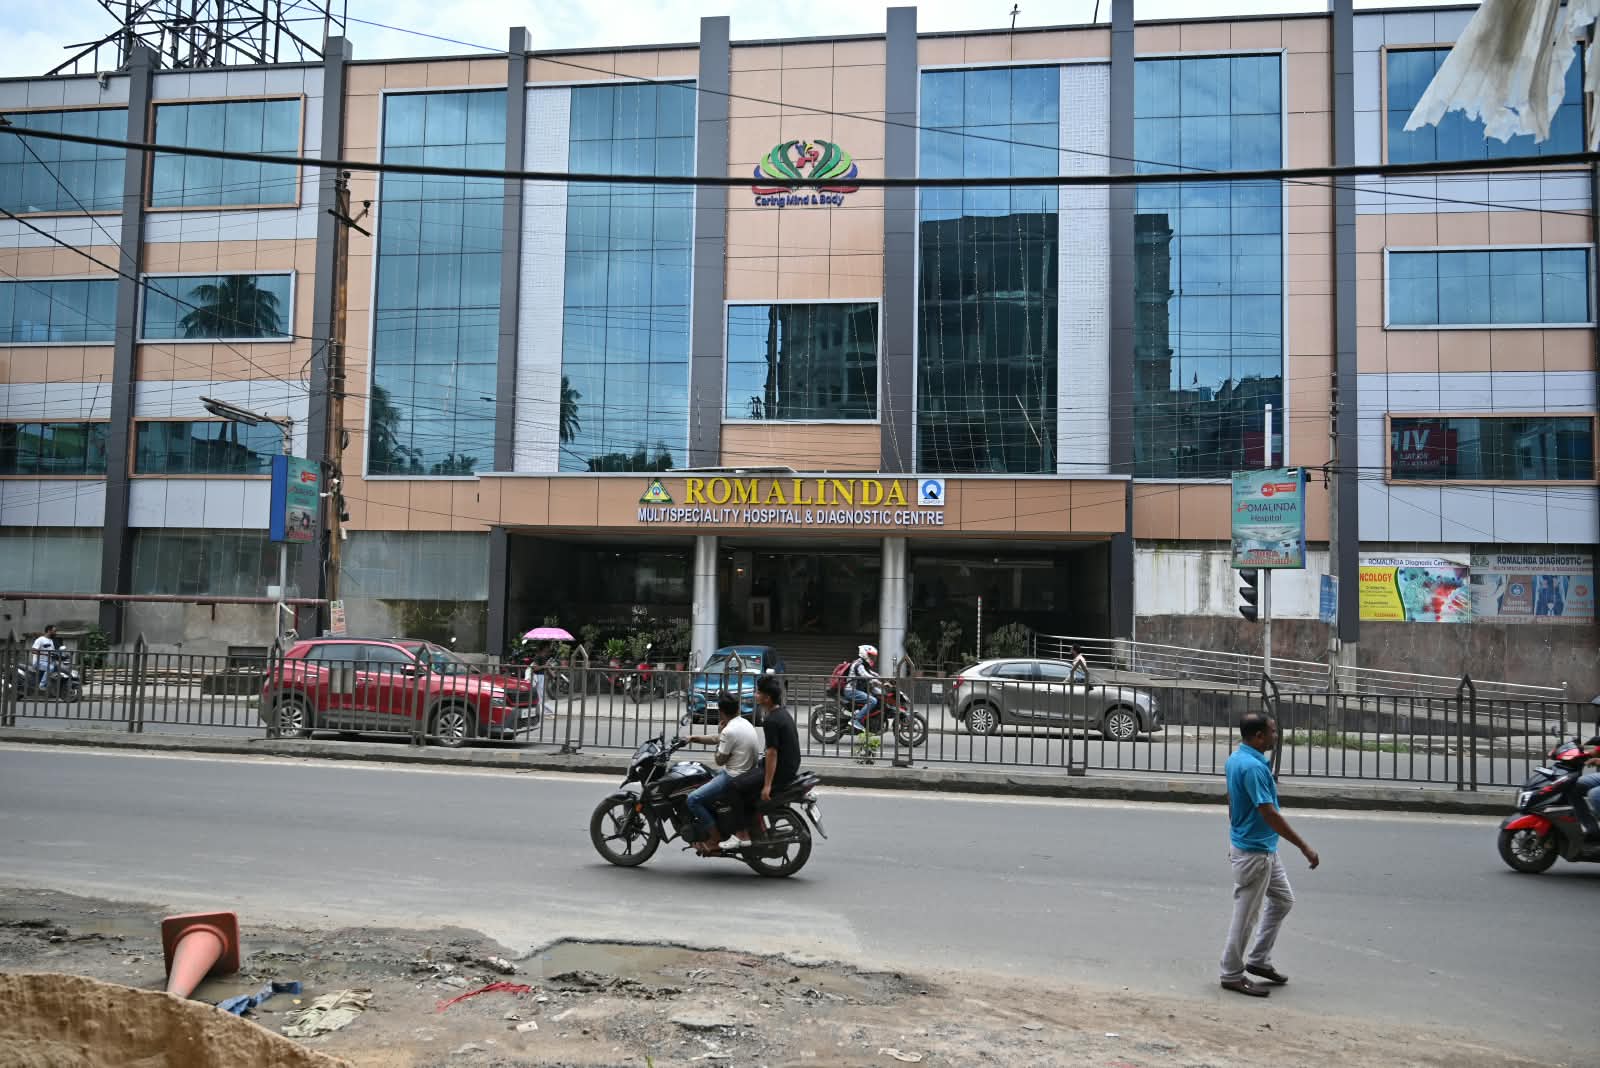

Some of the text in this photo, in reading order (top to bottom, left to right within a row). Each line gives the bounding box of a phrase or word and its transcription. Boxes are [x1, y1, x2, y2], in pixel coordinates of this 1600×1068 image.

[755, 194, 844, 208] Caring Mind & Body
[684, 478, 908, 506] ROMALINDA
[638, 507, 944, 525] MULTISPECIALITY HOSPITAL & DIAGNOSTIC CENTRE
[1250, 513, 1282, 522] Hospital
[1497, 555, 1538, 566] ROMALINDA
[1539, 556, 1582, 566] DIAGNOSTIC
[1360, 572, 1392, 582] NCOLOGY
